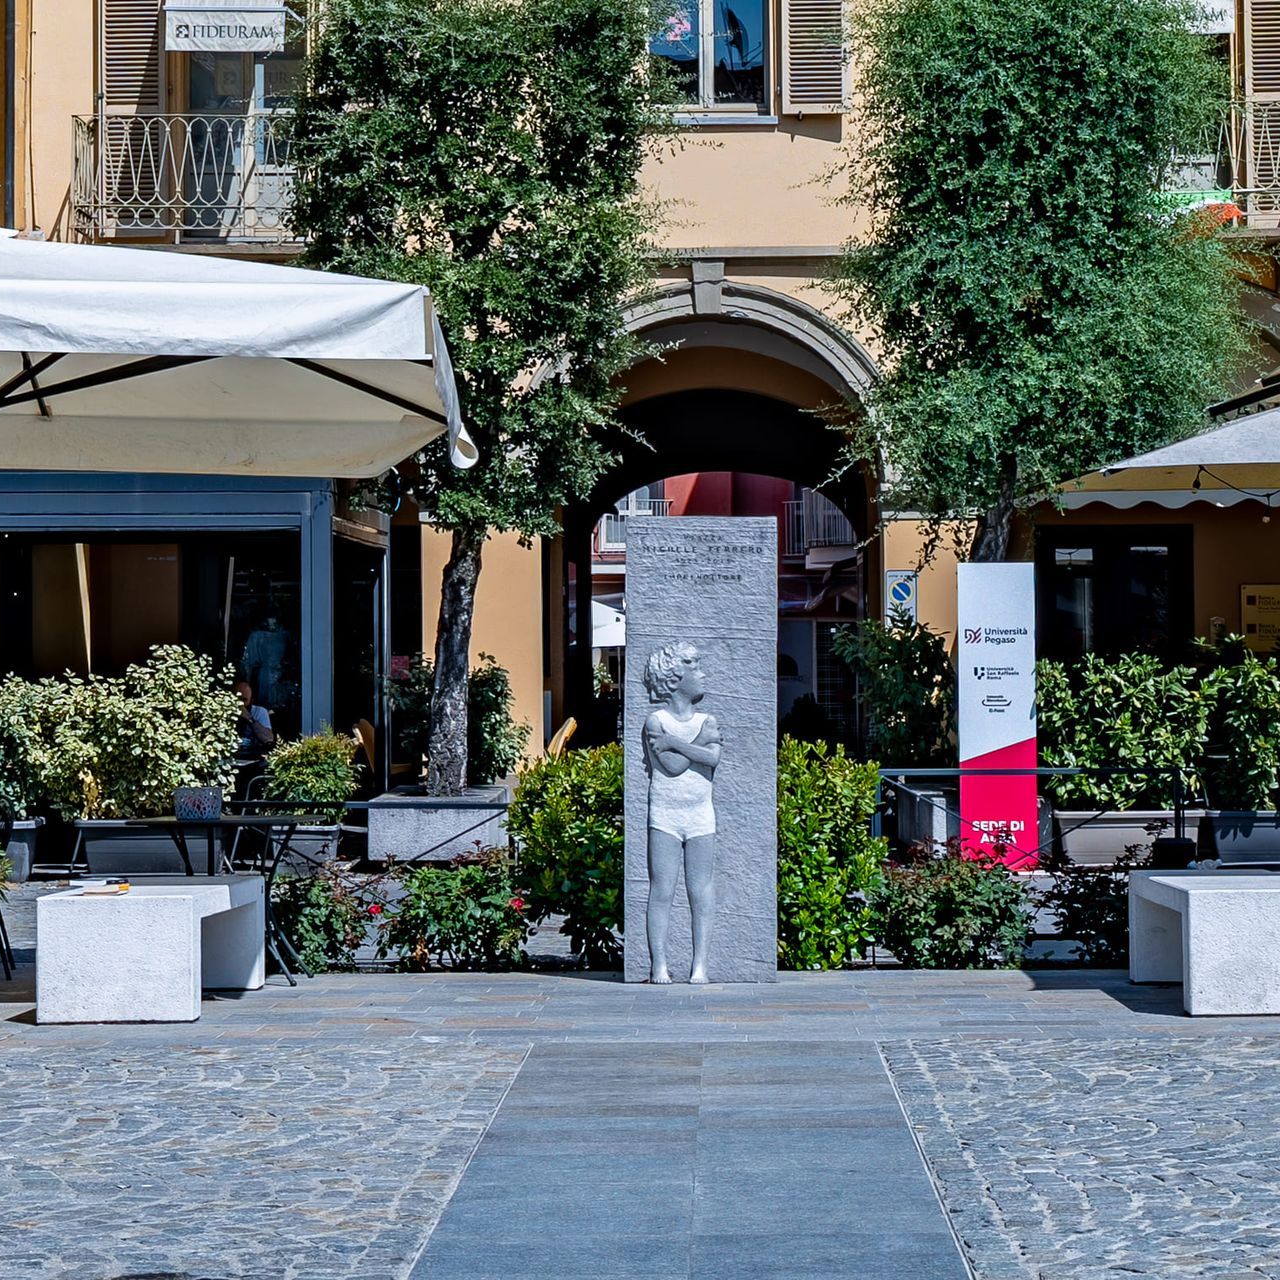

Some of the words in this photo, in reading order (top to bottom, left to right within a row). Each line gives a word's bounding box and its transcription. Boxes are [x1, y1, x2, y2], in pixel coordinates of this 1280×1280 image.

[192, 24, 274, 38] FIDEURAM
[642, 545, 697, 554] MICHELE
[708, 545, 763, 554] FERRERO
[984, 627, 1028, 636] Università
[984, 636, 1016, 645] Pegaso
[972, 821, 1007, 831] SEDE
[1010, 821, 1025, 831] DI
